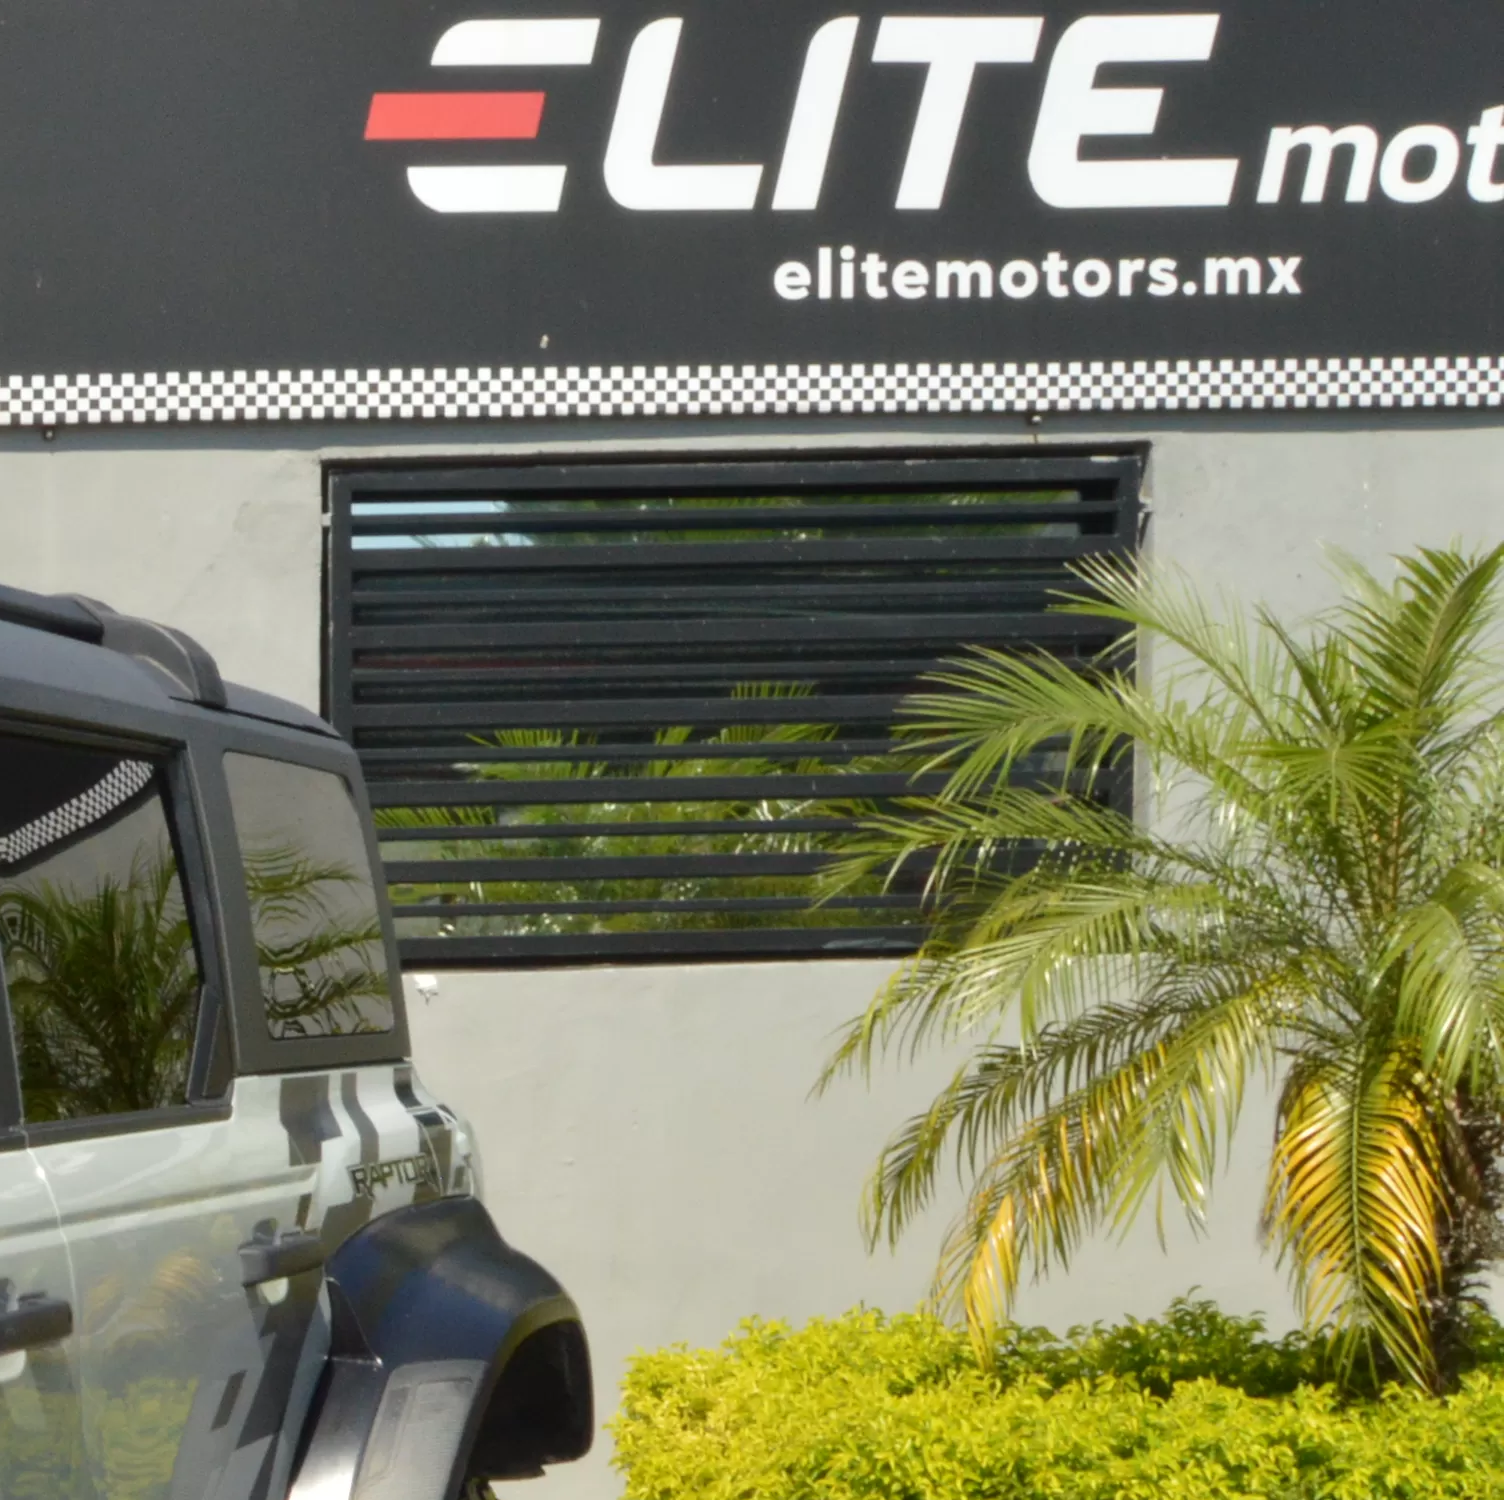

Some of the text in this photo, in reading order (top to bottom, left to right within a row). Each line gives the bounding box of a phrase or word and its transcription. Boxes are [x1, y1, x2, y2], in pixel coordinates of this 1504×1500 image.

[365, 16, 1240, 214] ELITE
[771, 245, 1304, 300] elitemotors.mx
[346, 1152, 440, 1200] RAPTOR
